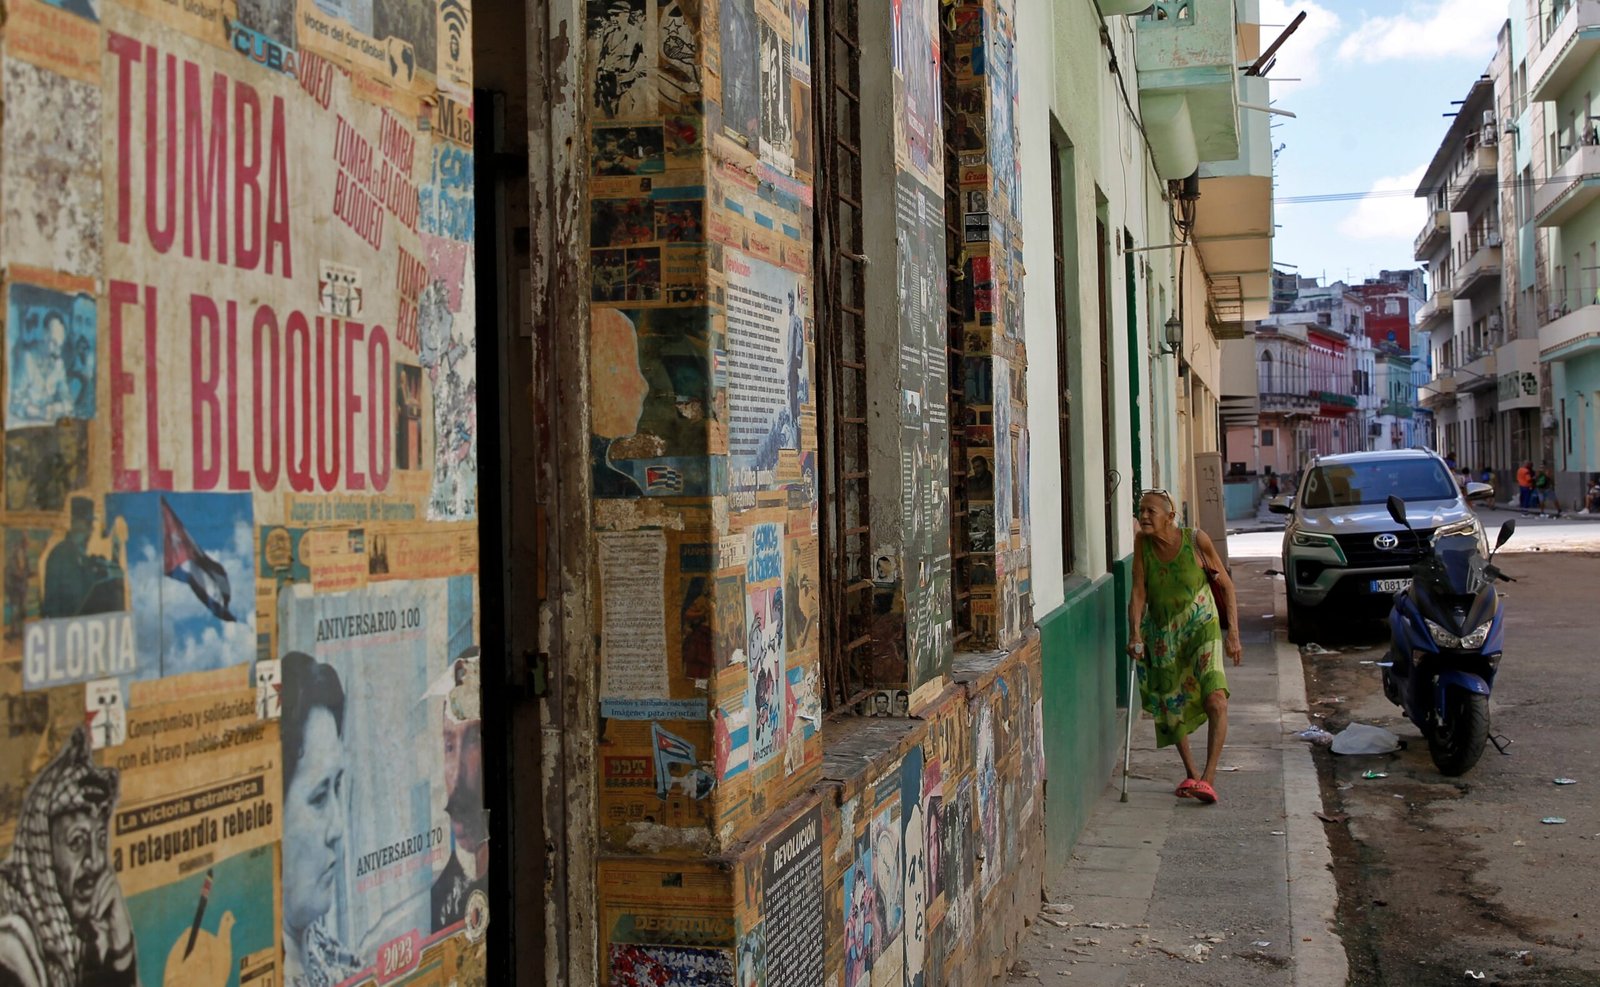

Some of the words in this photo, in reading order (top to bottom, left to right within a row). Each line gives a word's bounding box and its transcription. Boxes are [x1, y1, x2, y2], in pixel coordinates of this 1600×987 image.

[232, 31, 298, 78] CUBA
[304, 13, 328, 36] Voces
[330, 25, 345, 43] del
[347, 33, 361, 49] Sur
[361, 38, 386, 61] Global
[300, 49, 333, 110] QUEO
[379, 106, 416, 180] TUMBA
[437, 95, 472, 144] Mía
[107, 29, 292, 279] TUMBA
[333, 113, 374, 192] TUMBA
[333, 168, 384, 251] BLOQUEO
[380, 159, 419, 234] BLOQUE
[396, 245, 430, 302] TUMB
[109, 279, 173, 491] EL
[190, 294, 390, 492] BLOQUEO
[26, 615, 137, 684] GLORIA
[316, 610, 396, 642] ANIVERSARIO
[401, 607, 421, 629] 100
[128, 714, 194, 740] Compromiso
[203, 699, 255, 724] solidaridad
[117, 754, 137, 771] con
[140, 749, 150, 766] el
[153, 742, 181, 764] bravo
[120, 813, 137, 830] La
[141, 798, 191, 823] victoria
[194, 781, 258, 810] estratégica
[130, 818, 217, 868] retaguardia
[223, 800, 273, 838] rebelde
[356, 834, 423, 877] ANIVERSARIO
[425, 826, 443, 849] 170
[774, 818, 816, 874] REVOLUCIÓN
[383, 936, 413, 976] 2023
